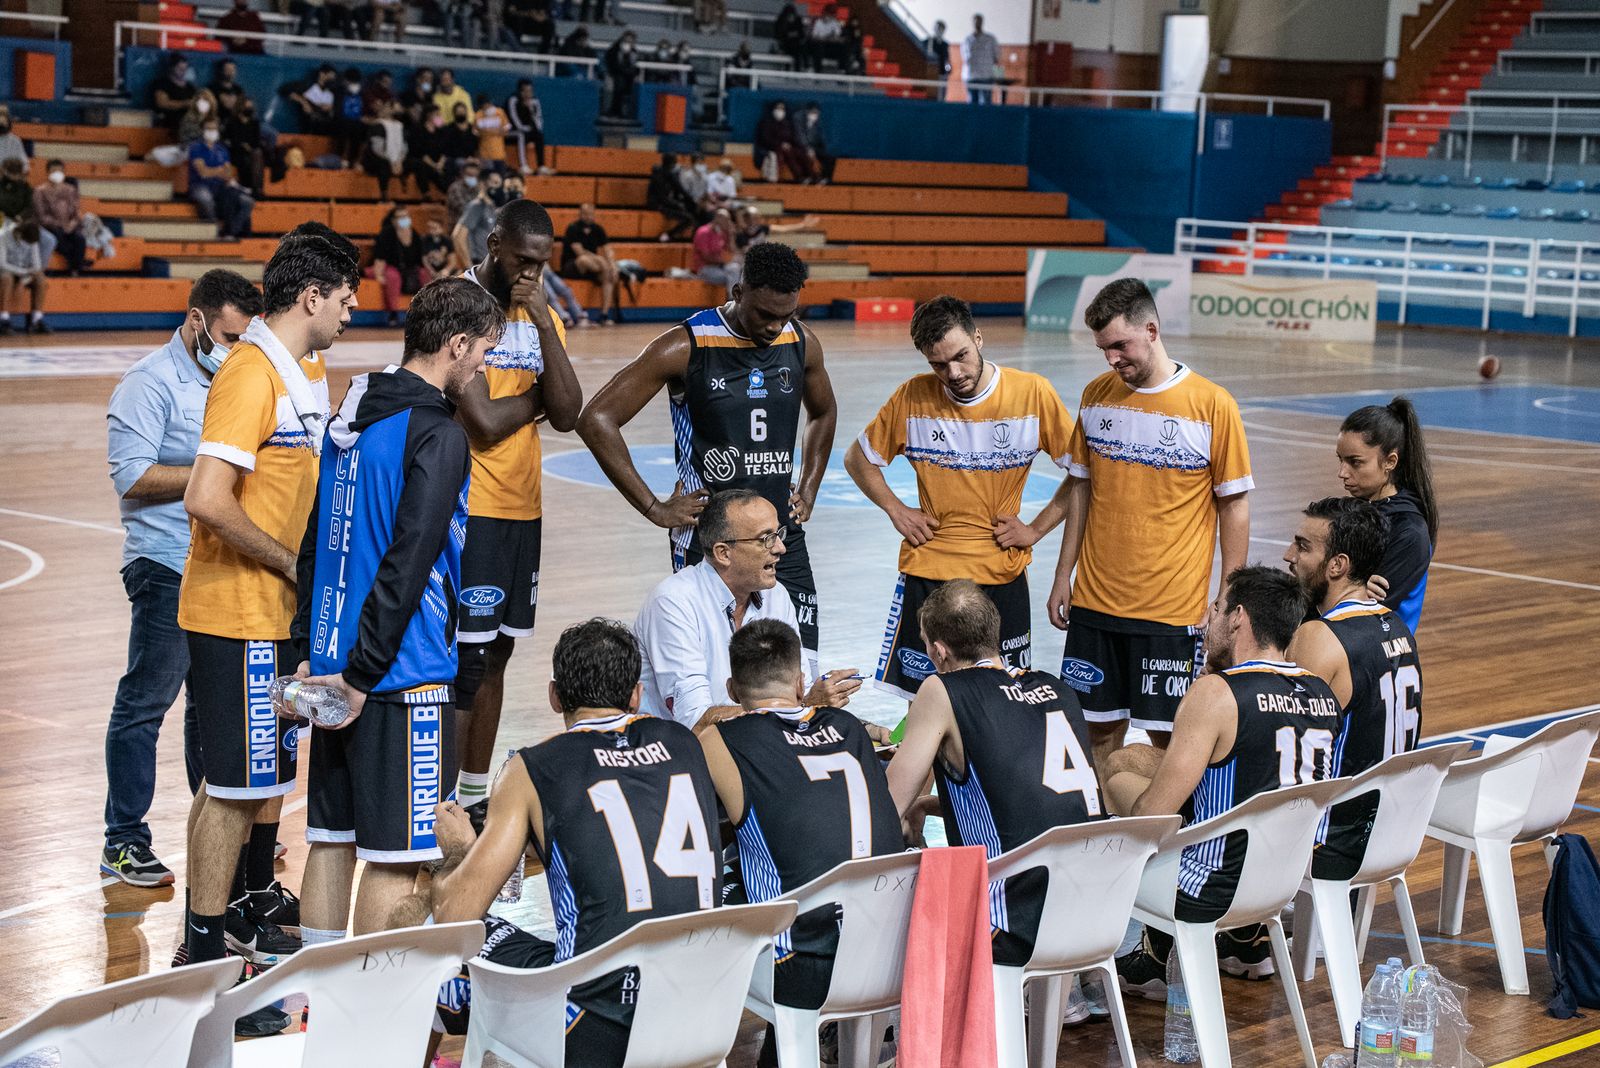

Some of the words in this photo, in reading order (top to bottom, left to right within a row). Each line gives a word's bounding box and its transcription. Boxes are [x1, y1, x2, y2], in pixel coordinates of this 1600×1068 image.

[750, 408, 768, 442] 6
[744, 452, 790, 465] HUELVA
[745, 465, 762, 476] TE
[326, 448, 360, 660] HUELVA
[469, 589, 497, 604] Ford
[902, 651, 929, 671] Ford
[1065, 661, 1095, 682] Ford
[1142, 674, 1159, 696] DE
[1379, 664, 1421, 761] 16
[593, 741, 672, 767] RISTORI
[1042, 709, 1100, 817] 4
[1275, 726, 1334, 789] 10
[412, 730, 439, 837] ENRIQUE
[797, 750, 872, 860] 7
[587, 773, 716, 912] 14
[357, 945, 419, 973] DXT
